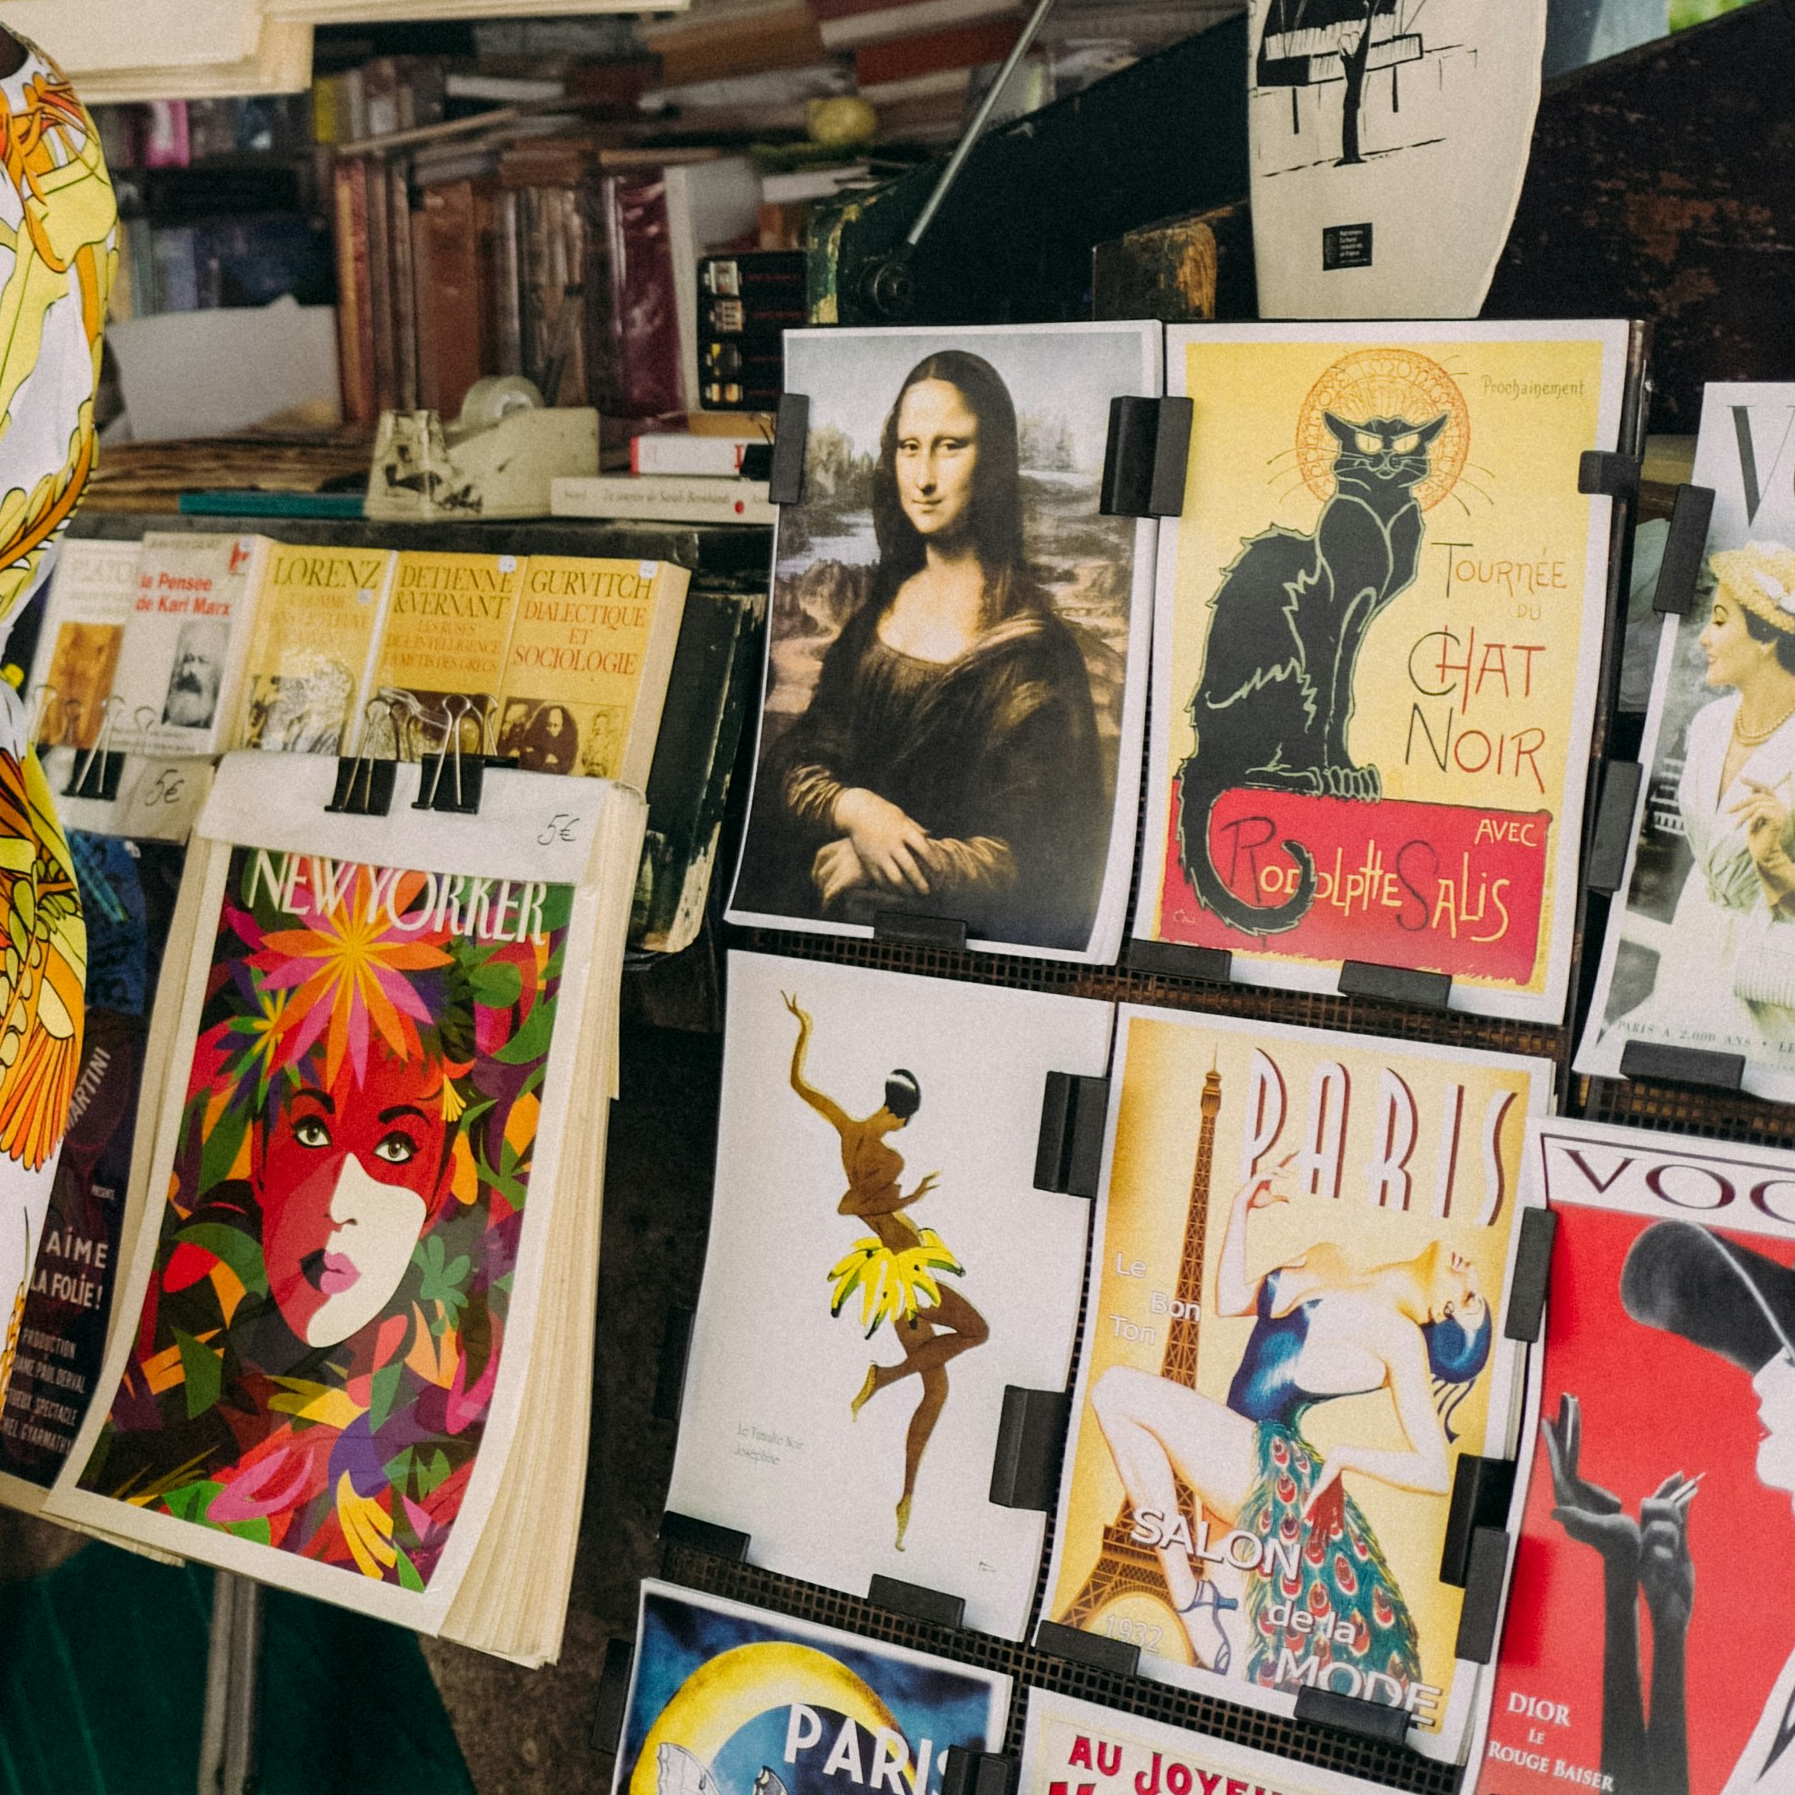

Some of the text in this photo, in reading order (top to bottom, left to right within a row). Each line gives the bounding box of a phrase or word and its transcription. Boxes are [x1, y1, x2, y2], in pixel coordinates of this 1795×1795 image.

[1481, 374, 1588, 400] Prochainement
[274, 557, 382, 589] LORENZ
[400, 565, 513, 593] DETIENNE
[531, 569, 653, 599] GURVITCH
[1431, 542, 1568, 598] TOURNÉE
[157, 596, 189, 615] Karl
[192, 597, 232, 616] Marx
[524, 600, 647, 631] DIALECTIQUE
[1516, 603, 1542, 621] DU
[568, 628, 593, 645] ET
[513, 644, 638, 675] SOCIOLOGIE
[1407, 624, 1546, 716] CHAT
[1405, 702, 1546, 795] NOIR
[537, 814, 580, 846] 5€
[1474, 818, 1538, 847] AVEC
[248, 849, 546, 946] NEW YORKER
[1396, 840, 1511, 943] SALIS
[1239, 1047, 1519, 1228] PARIS
[1115, 1252, 1147, 1279] Le
[1150, 1291, 1202, 1323] Bon
[1109, 1314, 1158, 1346] Ton
[1131, 1507, 1302, 1580] SALON
[1105, 1612, 1164, 1654] 1932
[1266, 1600, 1357, 1646] de la
[1273, 1647, 1443, 1727] MODE
[1507, 1691, 1571, 1727] DIOR
[1068, 1734, 1123, 1777] AU
